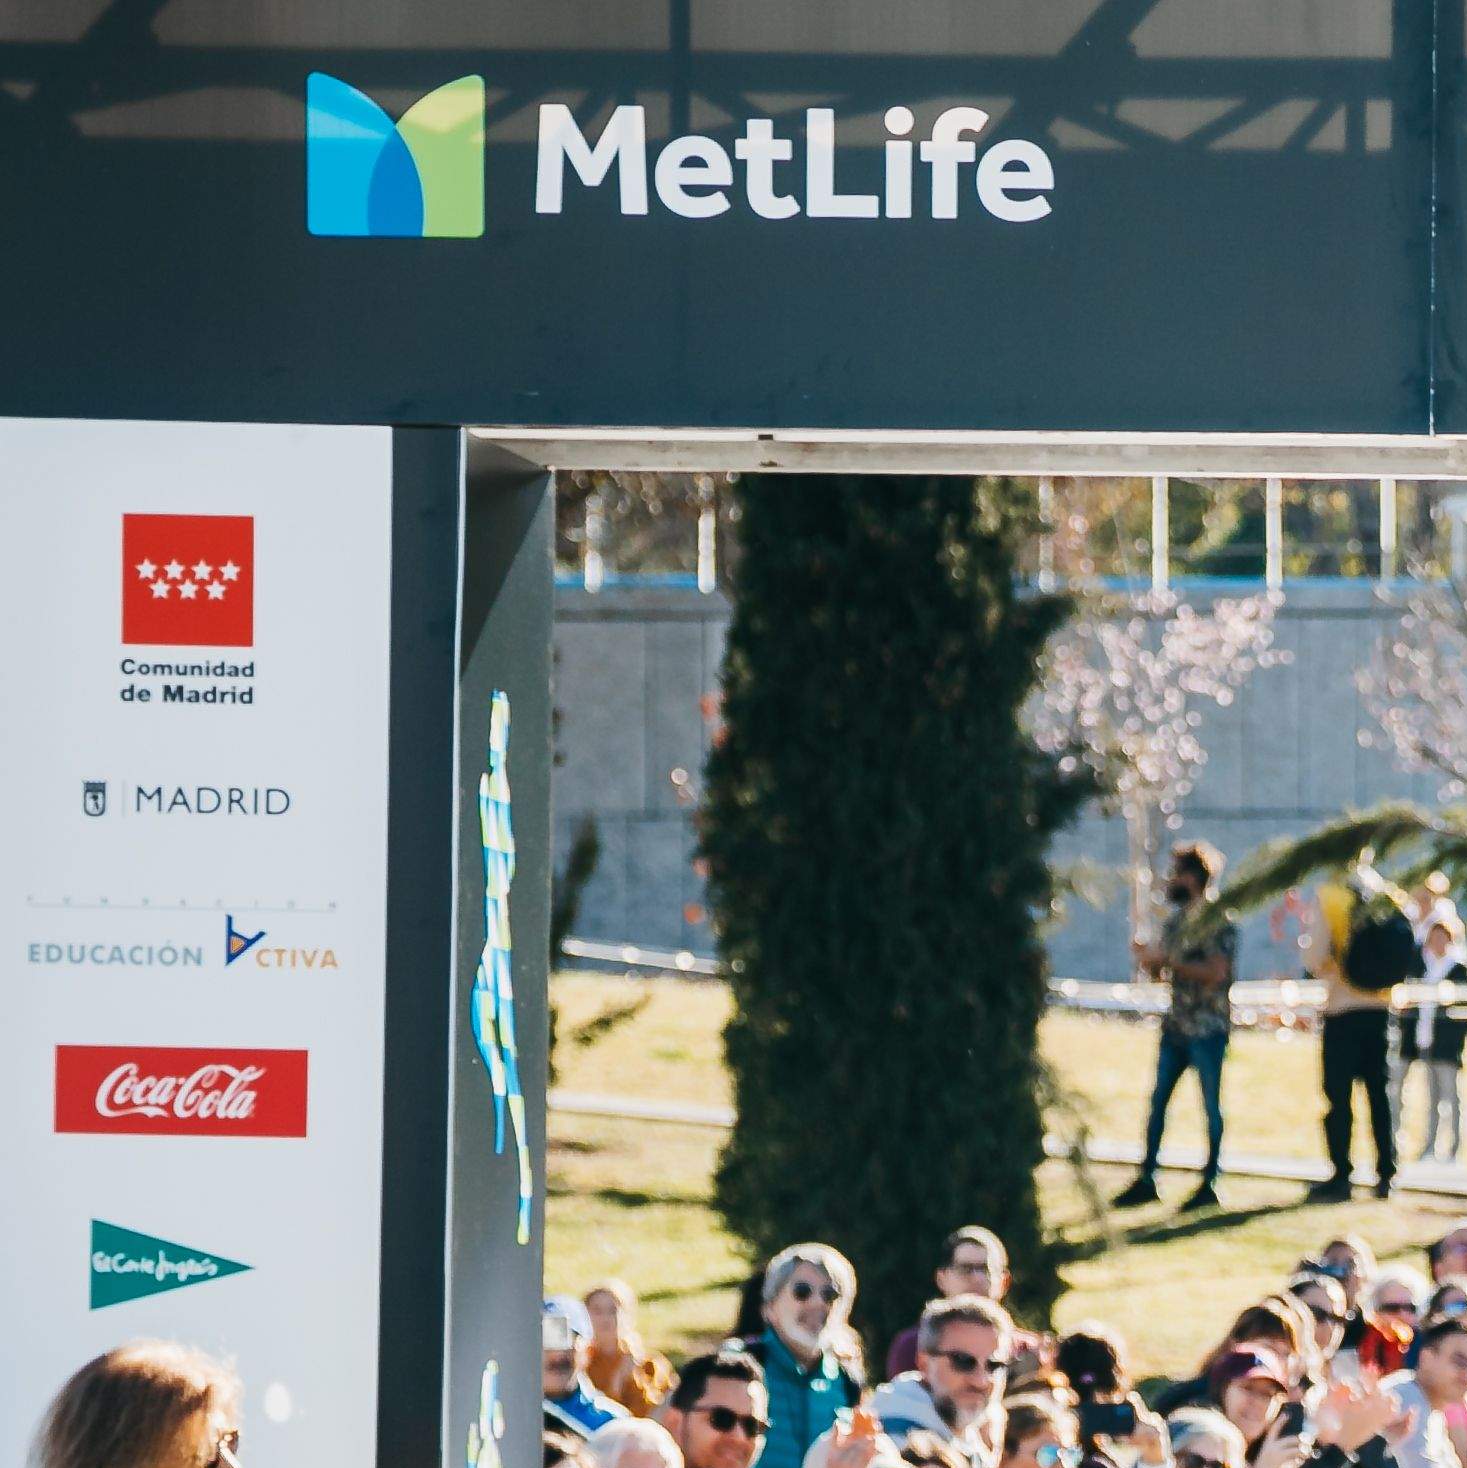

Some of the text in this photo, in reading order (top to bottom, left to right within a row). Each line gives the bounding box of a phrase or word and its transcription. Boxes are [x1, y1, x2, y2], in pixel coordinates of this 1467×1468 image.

[536, 104, 1056, 223] MetLife
[121, 658, 256, 679] Comunidad
[121, 685, 254, 706] de Madrid
[136, 786, 292, 816] MADRID
[28, 940, 204, 968] EDUCACIÓN
